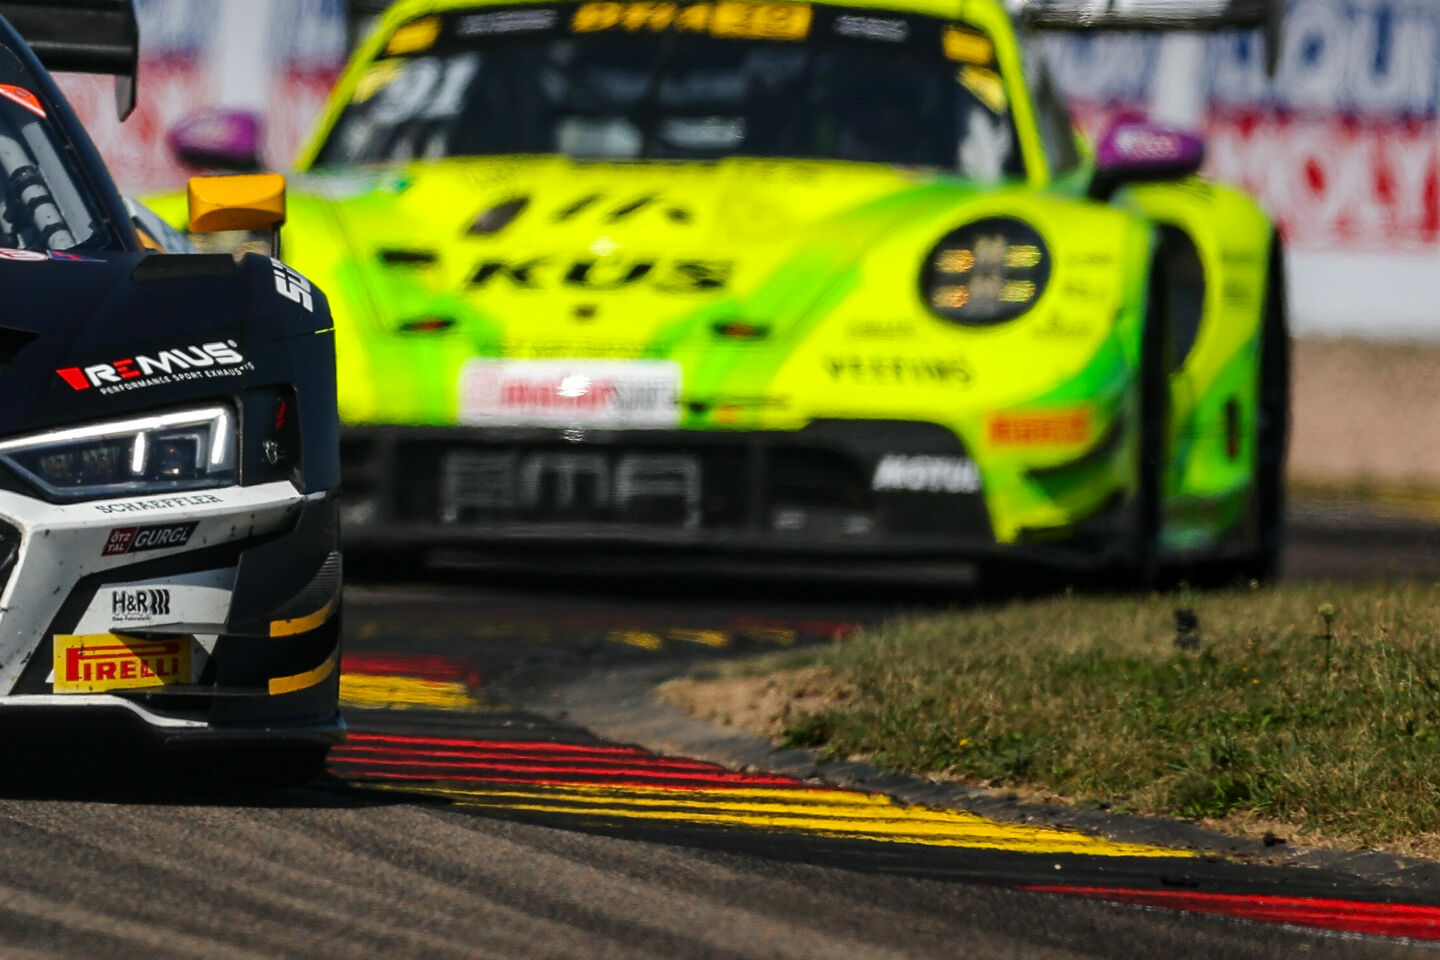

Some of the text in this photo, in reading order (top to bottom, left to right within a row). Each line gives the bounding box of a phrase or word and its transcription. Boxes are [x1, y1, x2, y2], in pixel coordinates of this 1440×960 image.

[83, 340, 244, 388] REMUS
[99, 376, 172, 395] PERFORMANCE
[173, 370, 203, 383] SPORT
[95, 494, 224, 514] SCHAEFFLER
[134, 526, 190, 547] GURGL
[112, 590, 149, 614] H&R
[66, 643, 180, 681] PIRELLI
